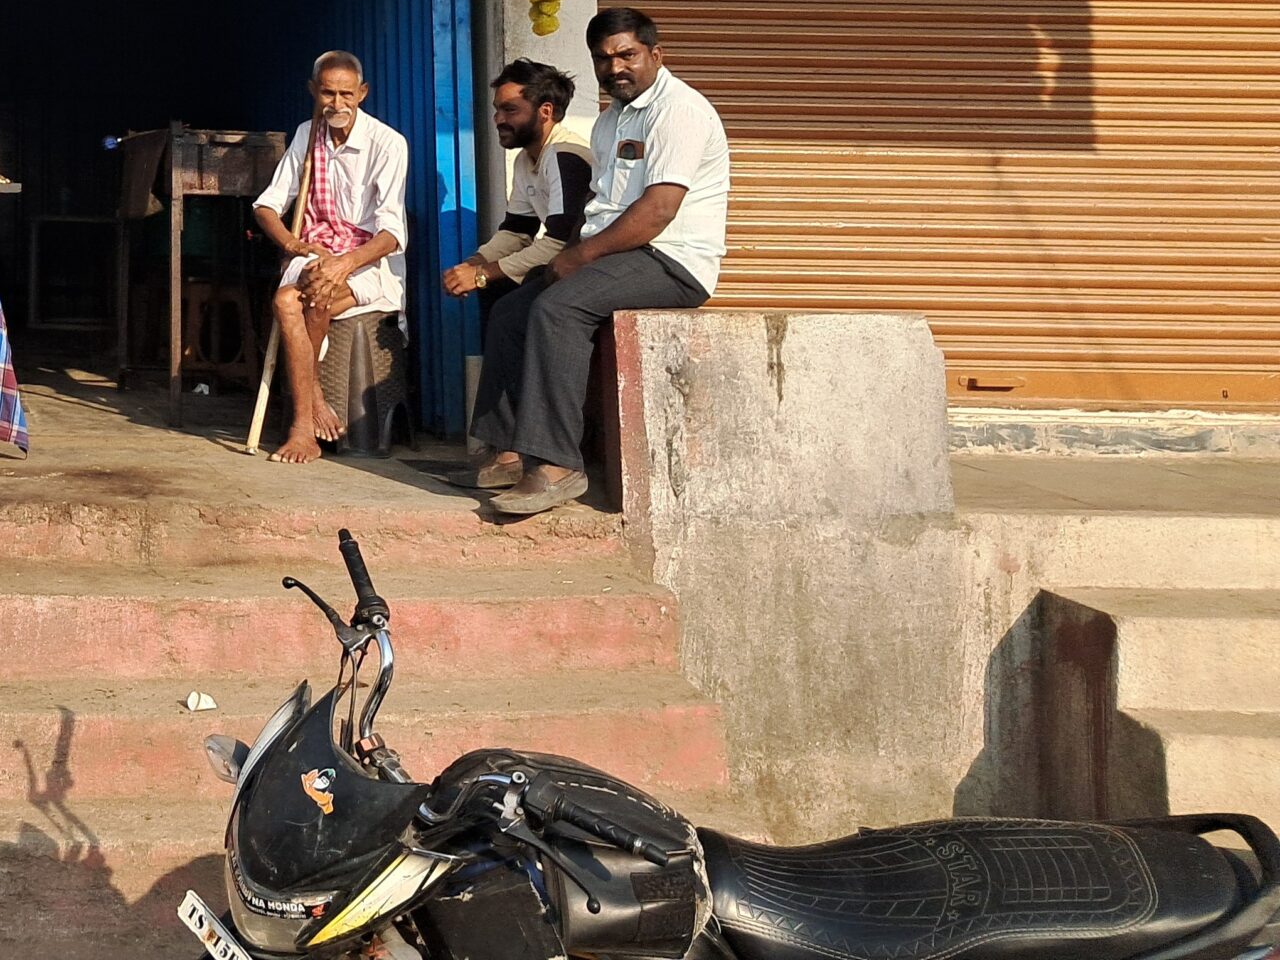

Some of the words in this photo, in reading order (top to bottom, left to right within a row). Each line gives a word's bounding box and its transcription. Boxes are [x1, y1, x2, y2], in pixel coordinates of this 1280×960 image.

[936, 840, 982, 906] STAR
[186, 903, 207, 930] TS
[267, 900, 306, 913] HONDA
